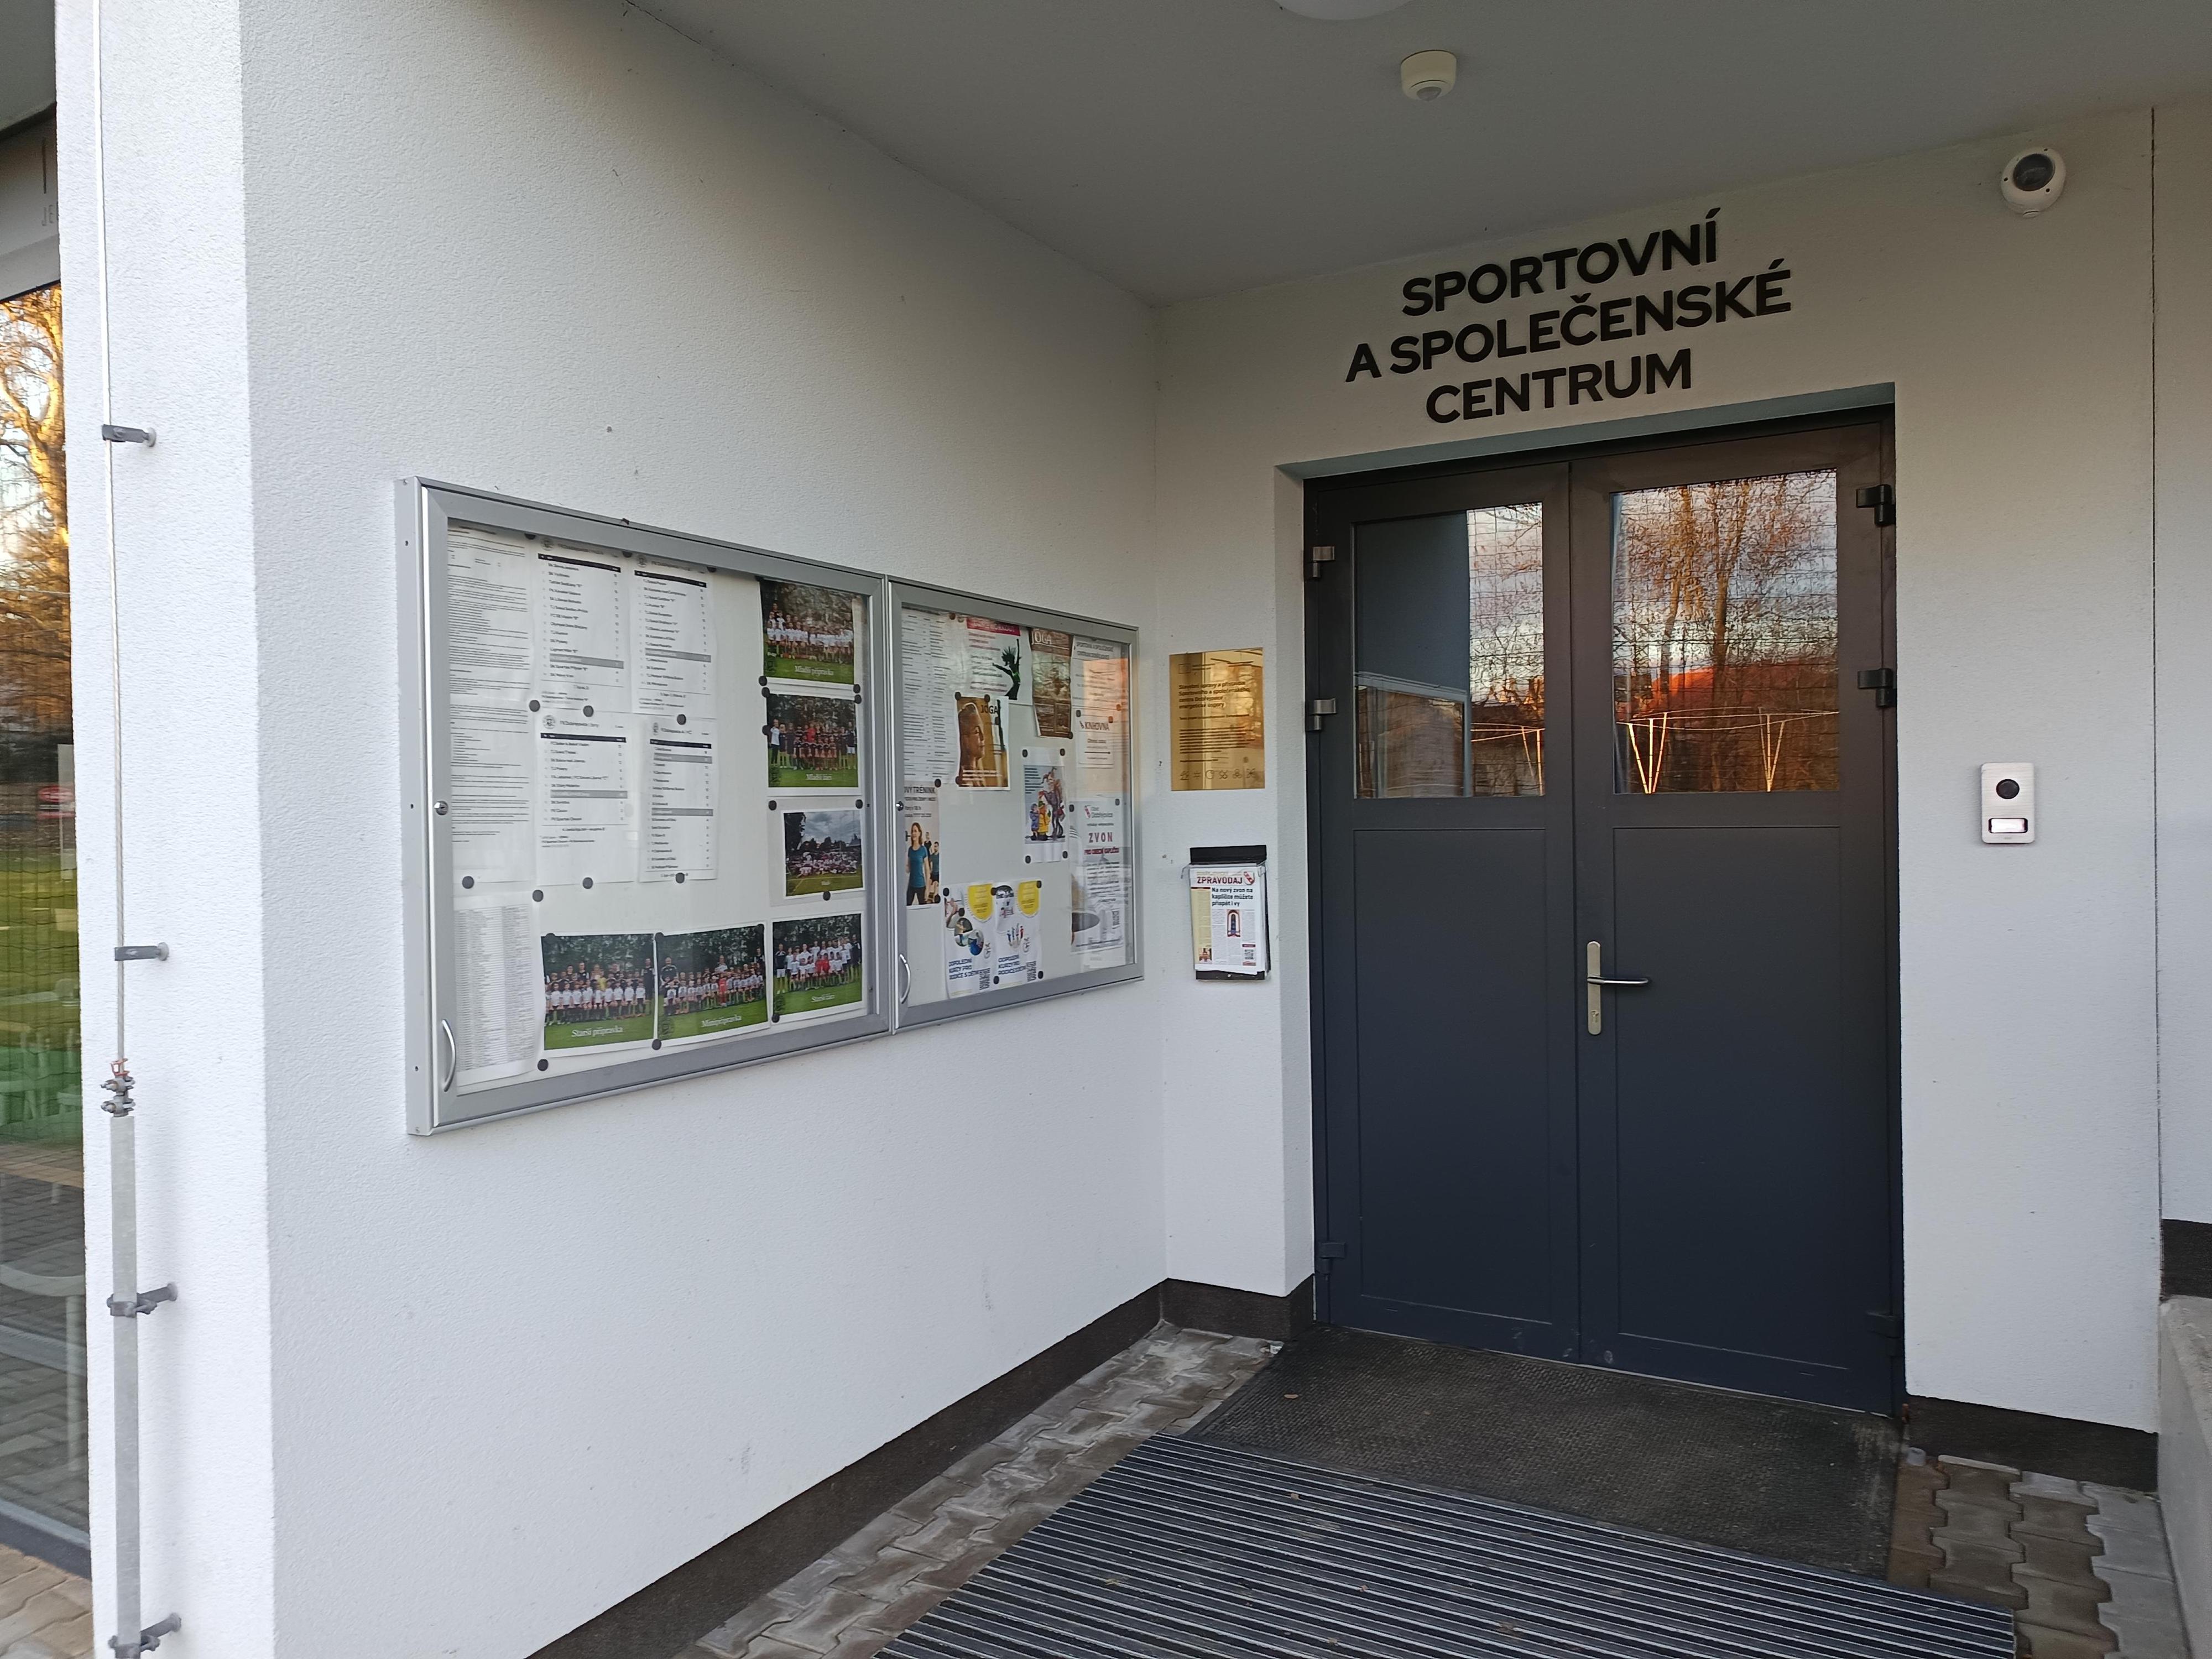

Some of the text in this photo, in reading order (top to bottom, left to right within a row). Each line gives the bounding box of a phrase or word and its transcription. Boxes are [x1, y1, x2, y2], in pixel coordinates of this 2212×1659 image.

[1402, 207, 1721, 316] SPORTOVNÍ
[1345, 258, 1792, 383] A SPOLEČENSKÉ
[1426, 348, 1692, 424] CENTRUM
[1088, 832, 1113, 843] ZVON
[571, 1028, 592, 1037] Starší
